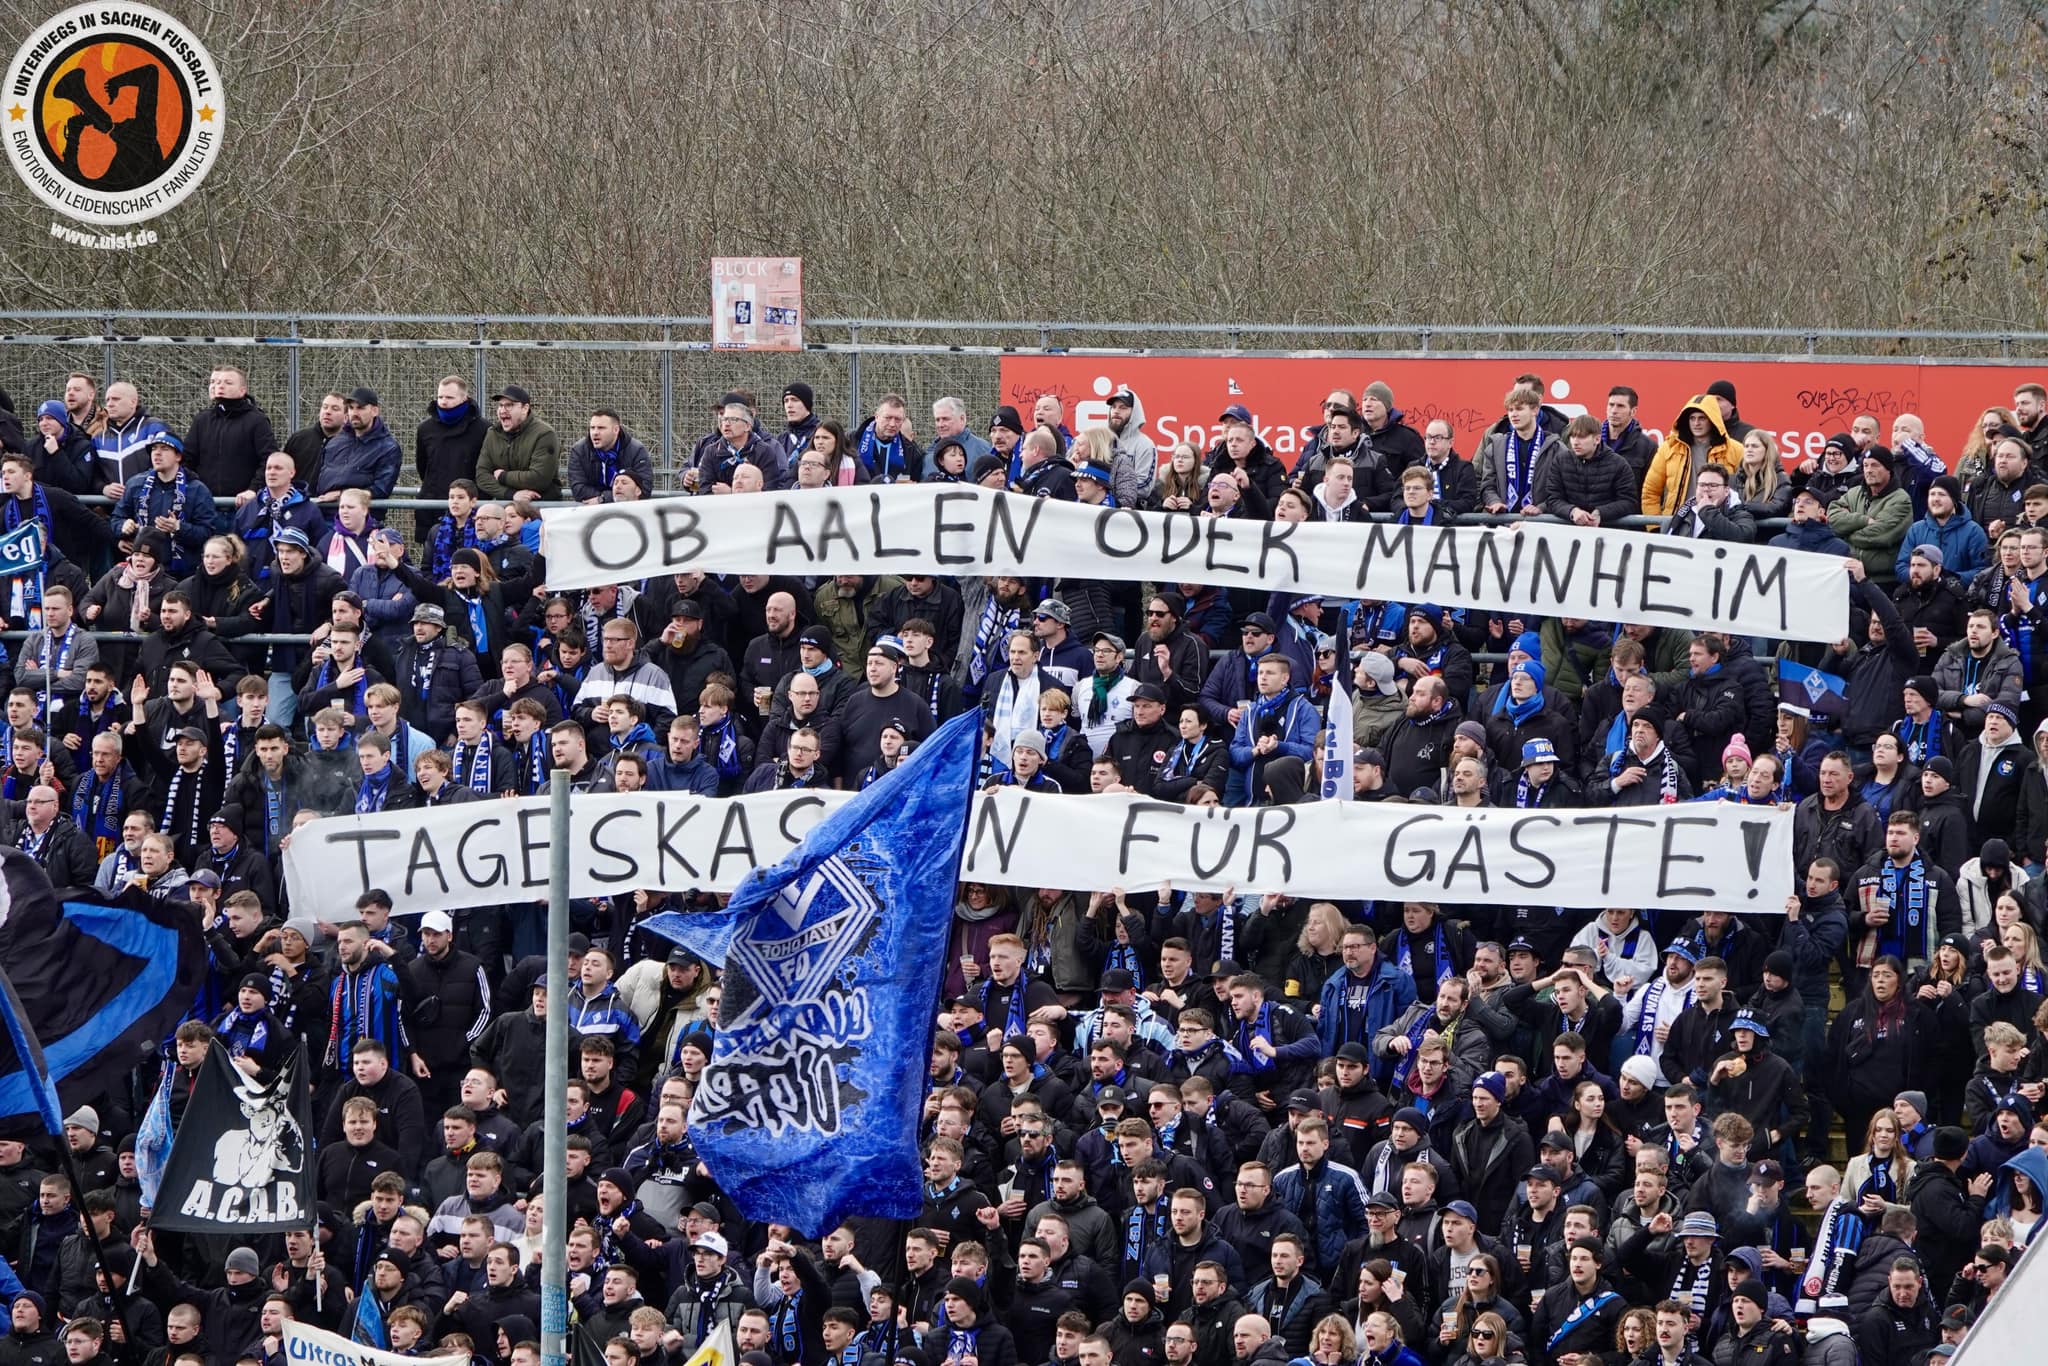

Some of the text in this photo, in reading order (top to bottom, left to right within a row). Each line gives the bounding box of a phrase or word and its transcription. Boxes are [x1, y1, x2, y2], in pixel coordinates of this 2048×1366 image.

[714, 261, 769, 277] BLOCK
[582, 504, 709, 571] OB
[766, 491, 1045, 565] AALEN
[1096, 507, 1300, 584] ODER
[325, 796, 1771, 900] TAGESKASN FÜR GÄSTE!
[180, 1178, 305, 1224] A.C.A.B.
